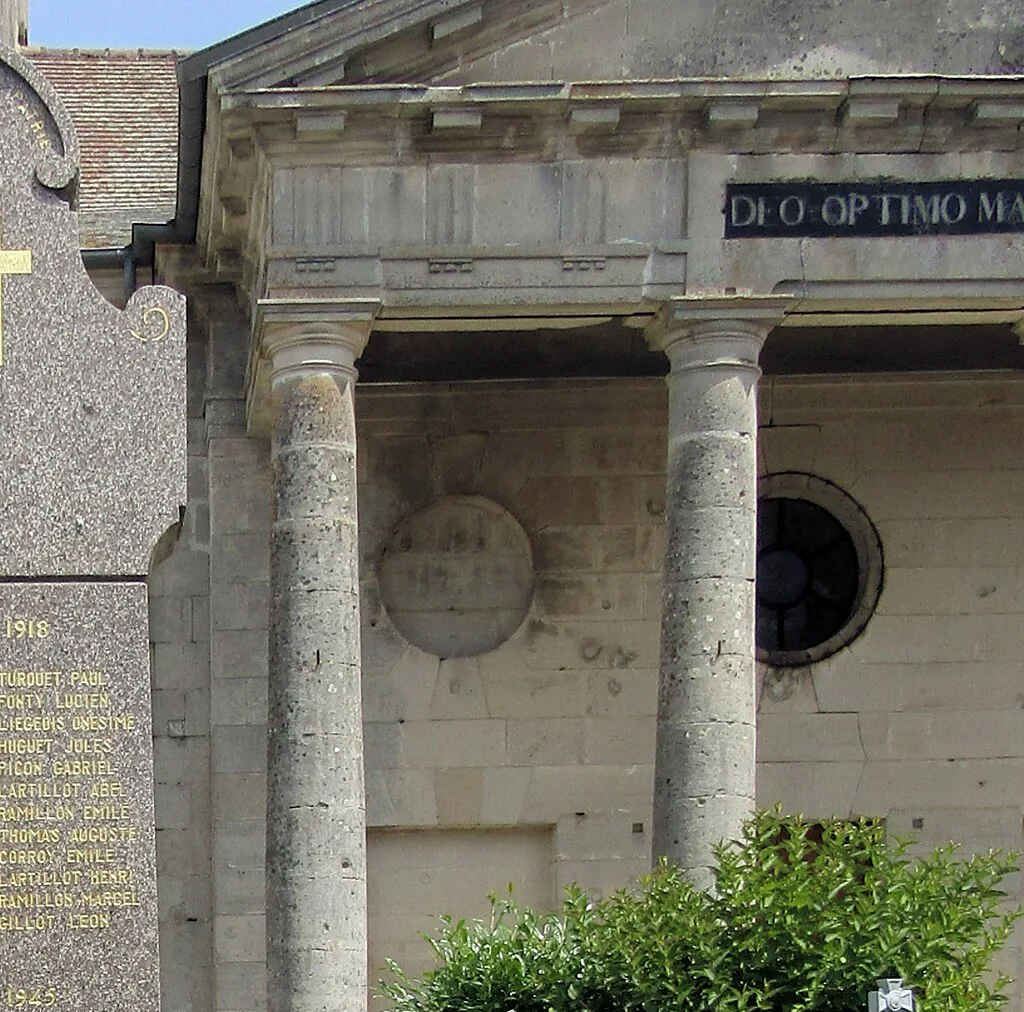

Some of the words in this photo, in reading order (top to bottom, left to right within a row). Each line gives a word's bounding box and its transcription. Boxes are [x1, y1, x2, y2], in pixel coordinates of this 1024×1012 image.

[821, 192, 967, 227] OPTIMO
[5, 618, 49, 639] 1918
[70, 671, 107, 686] PAUL
[55, 693, 109, 709] LUCIEN
[72, 715, 136, 731] ONESIME
[64, 738, 113, 753] JULES
[53, 760, 115, 775] GABRIEL
[89, 782, 127, 798] ABEL
[83, 805, 130, 820] EMILE
[70, 827, 138, 842] AUGUSTE
[67, 849, 116, 863] EMILE
[90, 870, 134, 885] HENRI
[81, 891, 141, 906] MARCEL
[69, 914, 110, 929] LEON
[7, 986, 57, 1007] 1945
